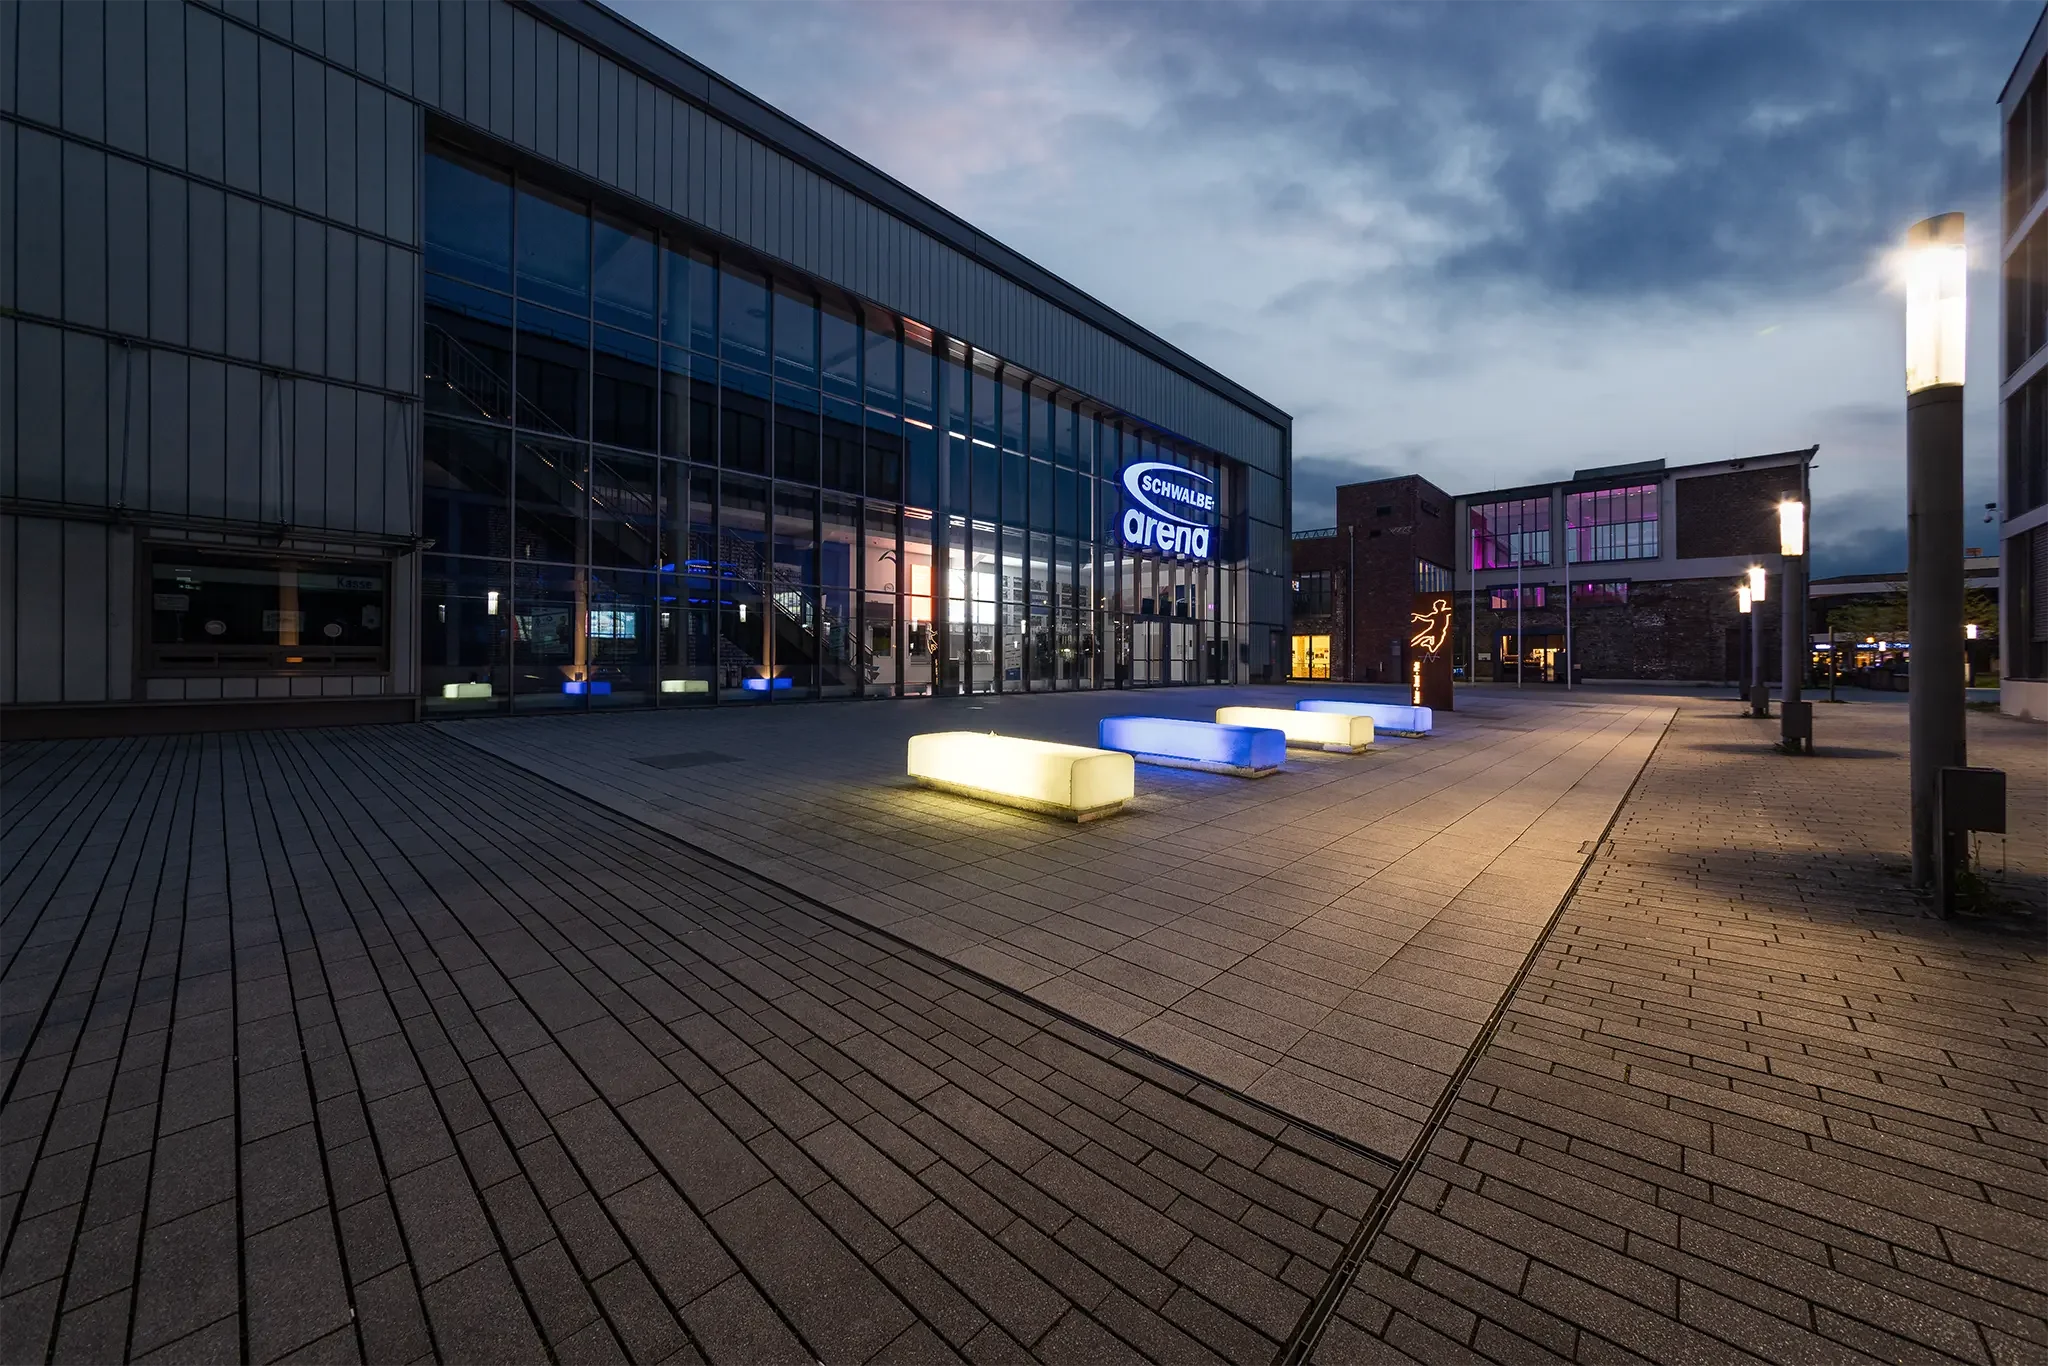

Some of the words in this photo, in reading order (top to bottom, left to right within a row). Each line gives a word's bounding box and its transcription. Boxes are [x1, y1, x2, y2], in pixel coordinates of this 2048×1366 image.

[1142, 475, 1213, 510] SCHWALBE
[1124, 509, 1210, 558] arena
[337, 576, 373, 589] Kasse
